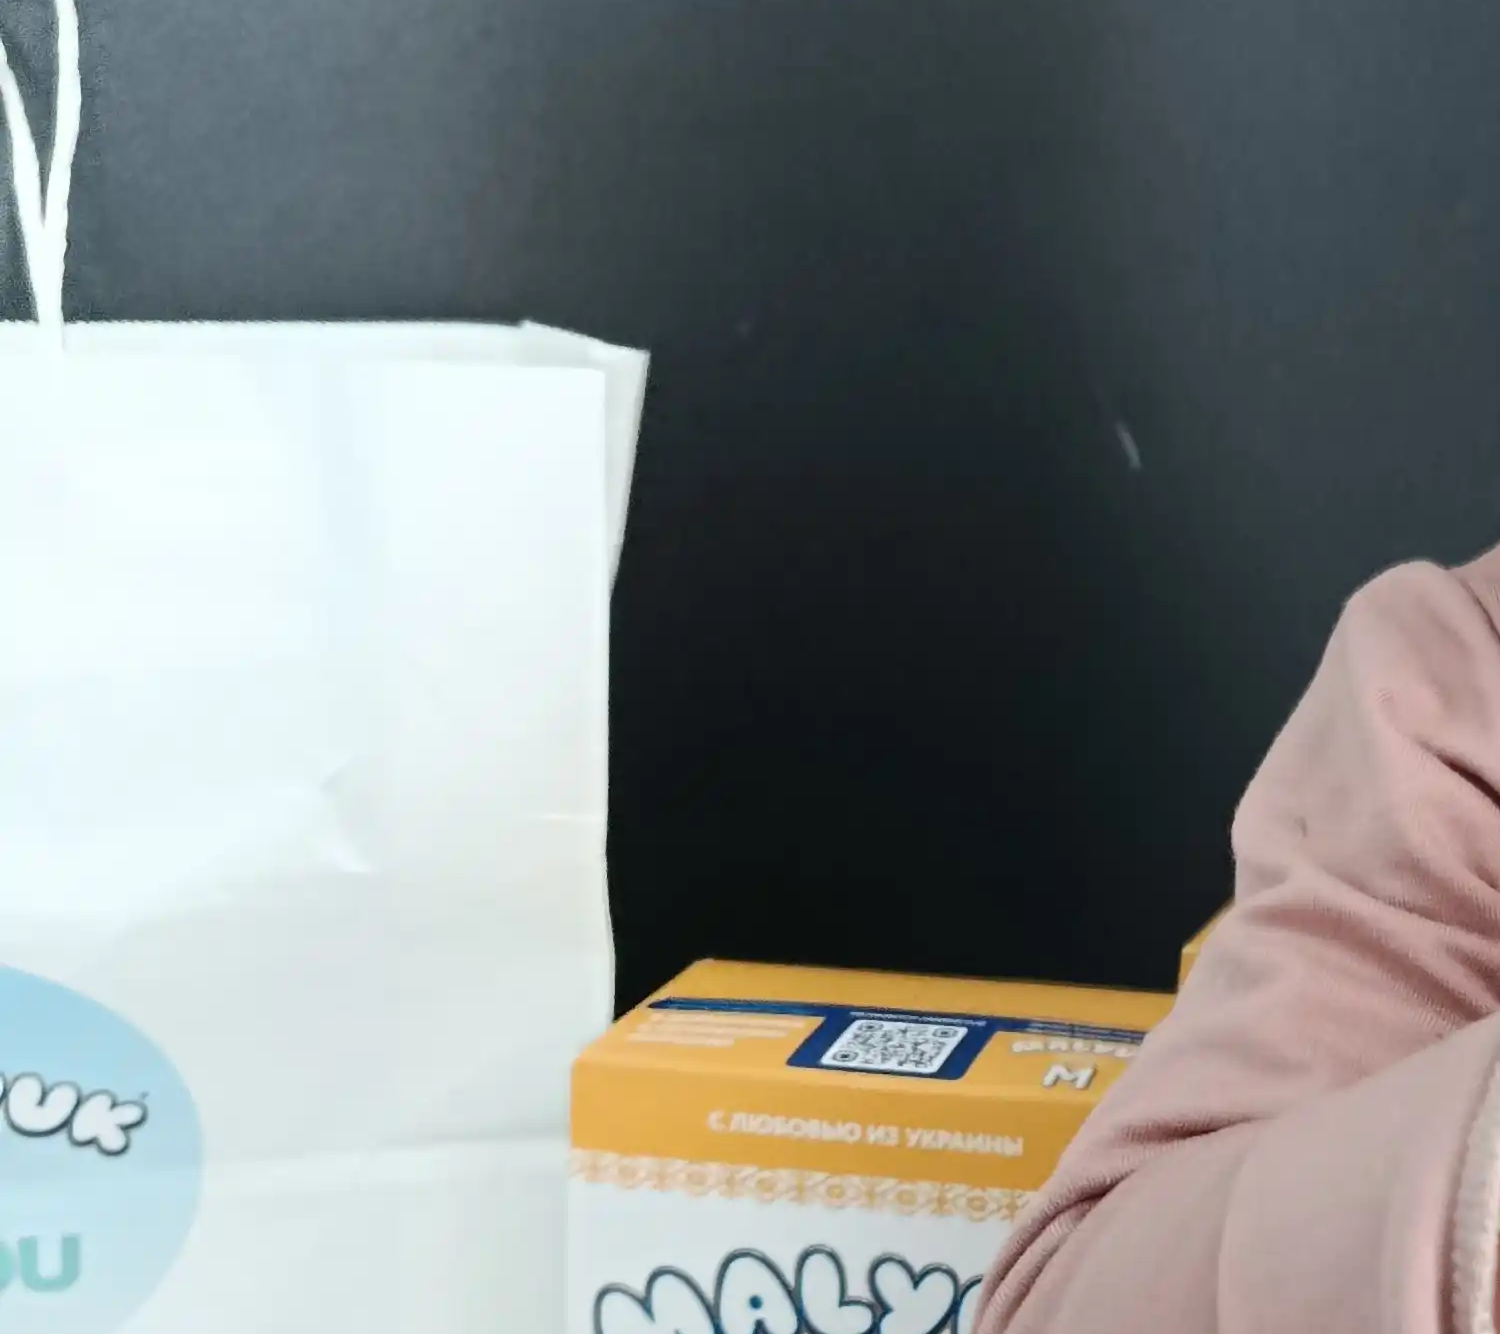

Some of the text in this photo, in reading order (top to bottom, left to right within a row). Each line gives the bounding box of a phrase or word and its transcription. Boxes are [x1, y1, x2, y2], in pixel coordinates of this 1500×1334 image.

[0, 1071, 148, 1157] UK
[730, 1111, 861, 1145] ЛЮБОВЬЮ
[866, 1123, 899, 1146] ИЗ
[905, 1126, 1025, 1157] УКРАИНЫ
